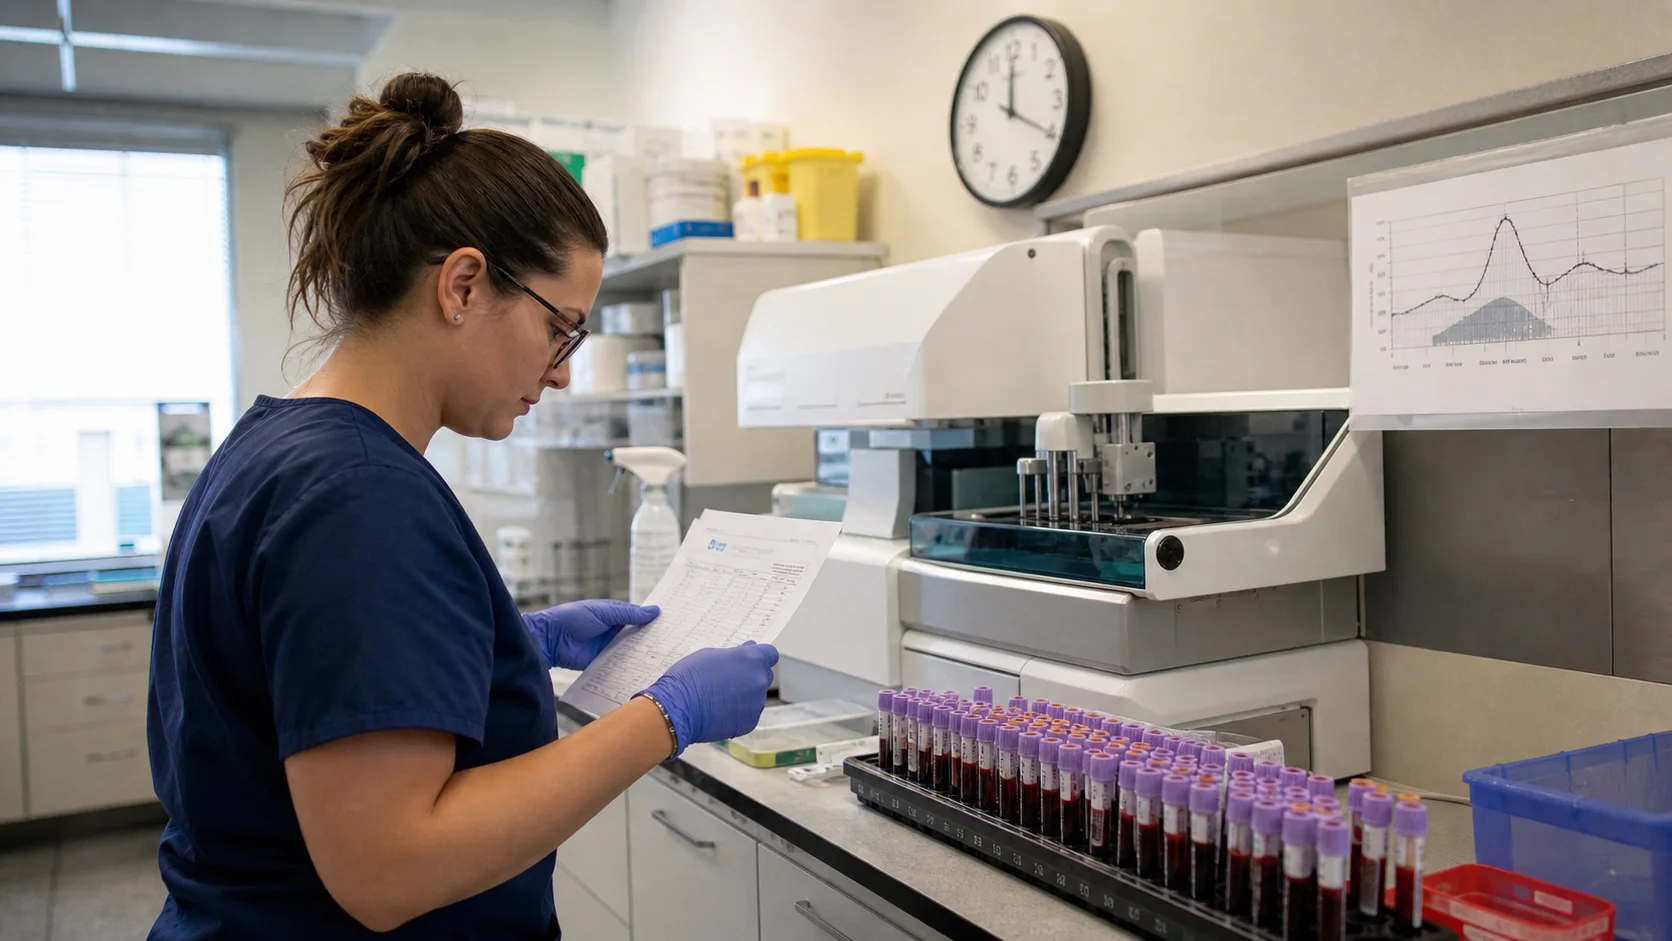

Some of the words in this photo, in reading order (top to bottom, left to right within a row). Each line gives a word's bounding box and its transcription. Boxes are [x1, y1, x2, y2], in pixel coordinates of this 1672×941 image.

[1006, 40, 1021, 60] 12
[1032, 42, 1037, 61] 1
[988, 54, 1000, 73] 11
[1045, 58, 1056, 80] 2
[975, 81, 989, 102] 10
[1053, 88, 1063, 110] 3
[966, 115, 977, 135] 9
[972, 143, 983, 162] 8
[1030, 150, 1041, 172] 5
[988, 162, 997, 182] 7
[1007, 165, 1018, 186] 6
